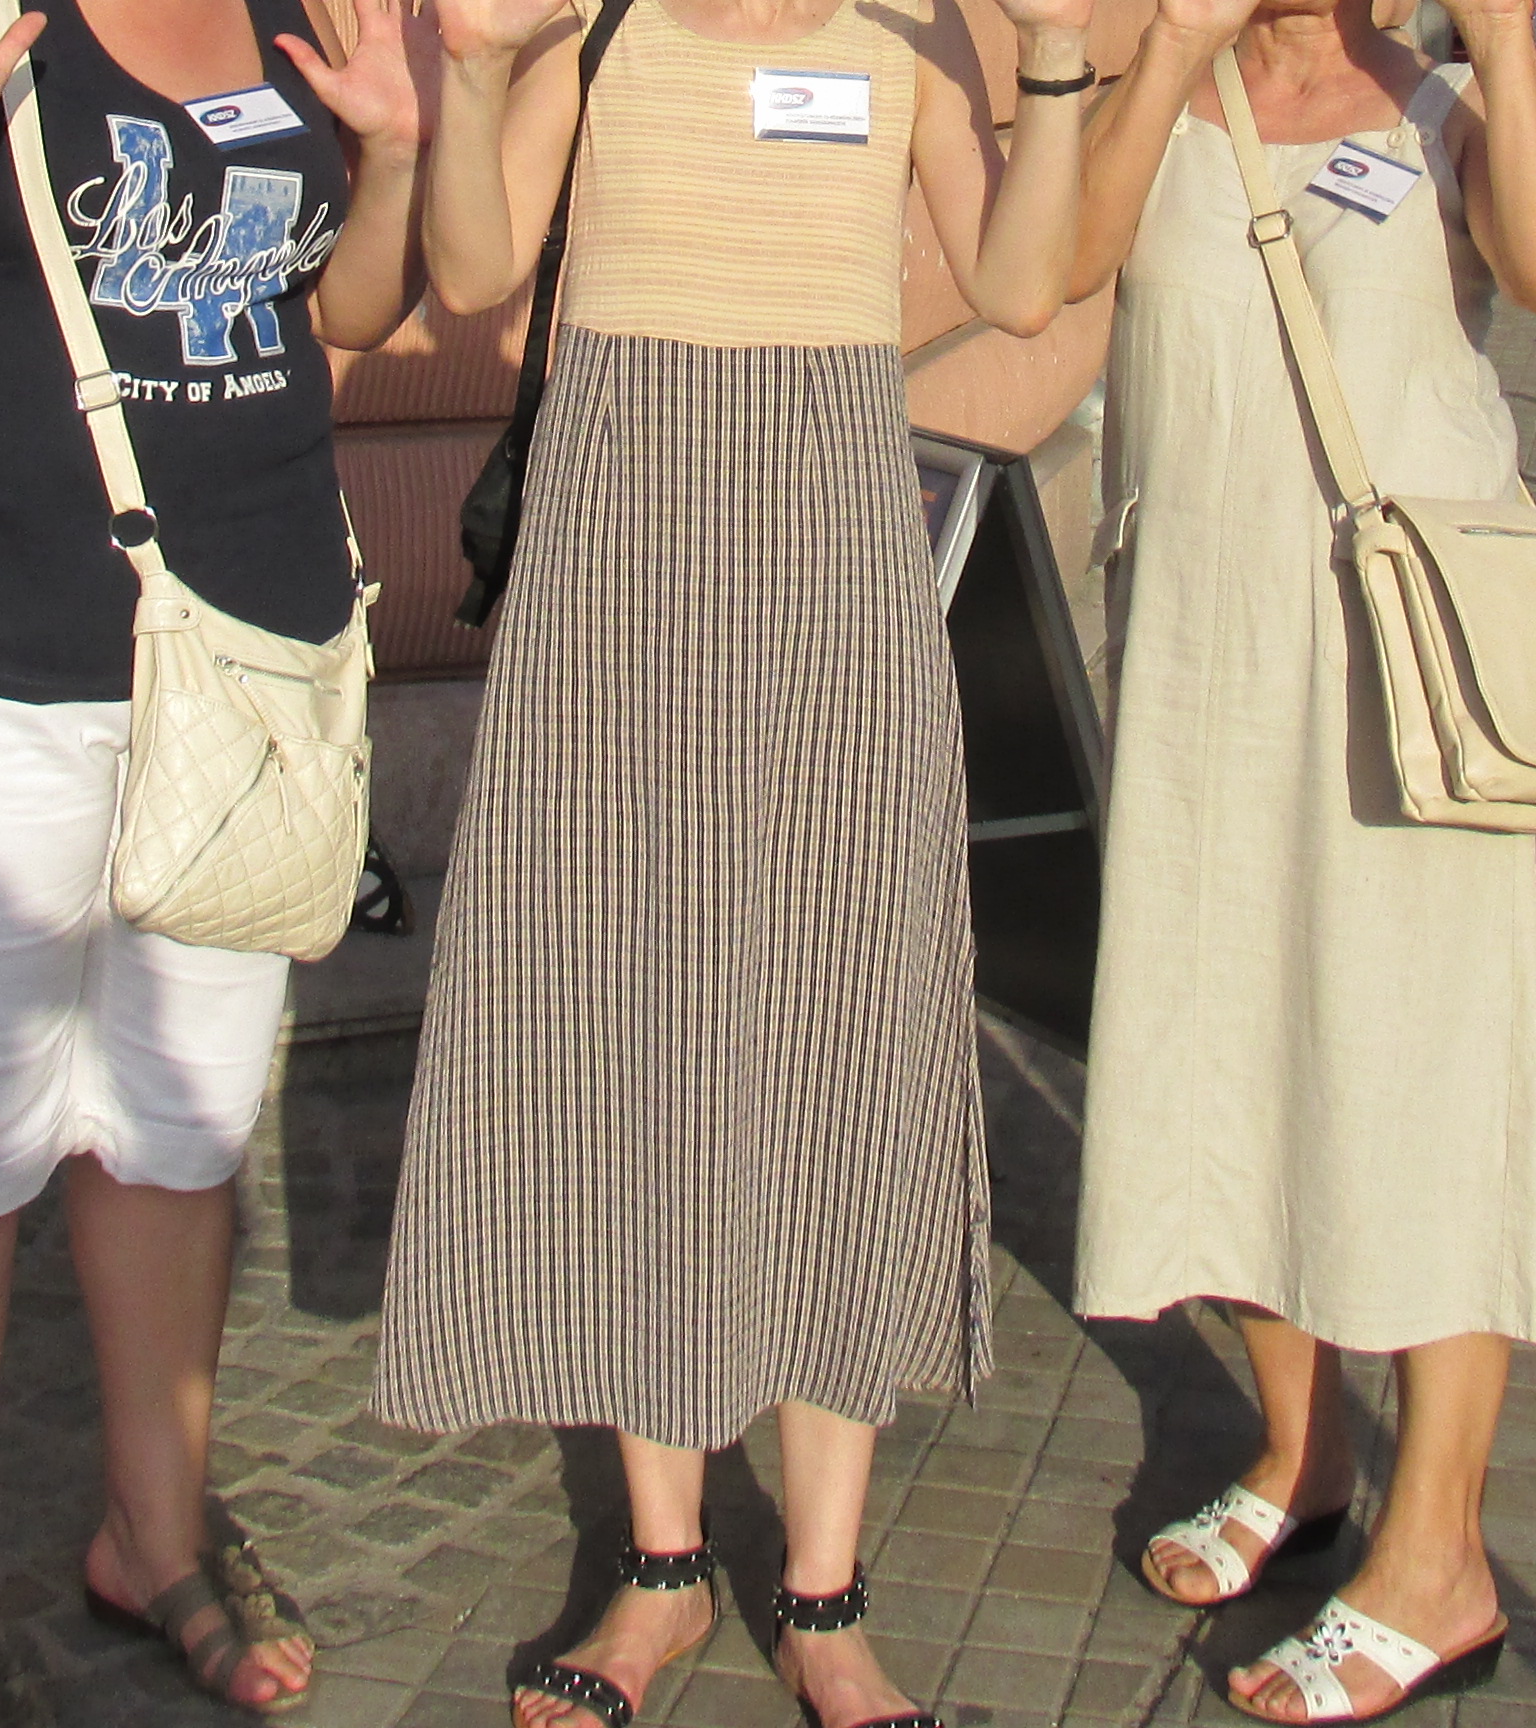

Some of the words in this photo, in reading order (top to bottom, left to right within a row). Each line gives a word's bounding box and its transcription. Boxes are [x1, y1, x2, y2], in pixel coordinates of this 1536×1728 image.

[66, 161, 194, 260] Los
[114, 373, 180, 402] CITY
[187, 381, 212, 403] OF
